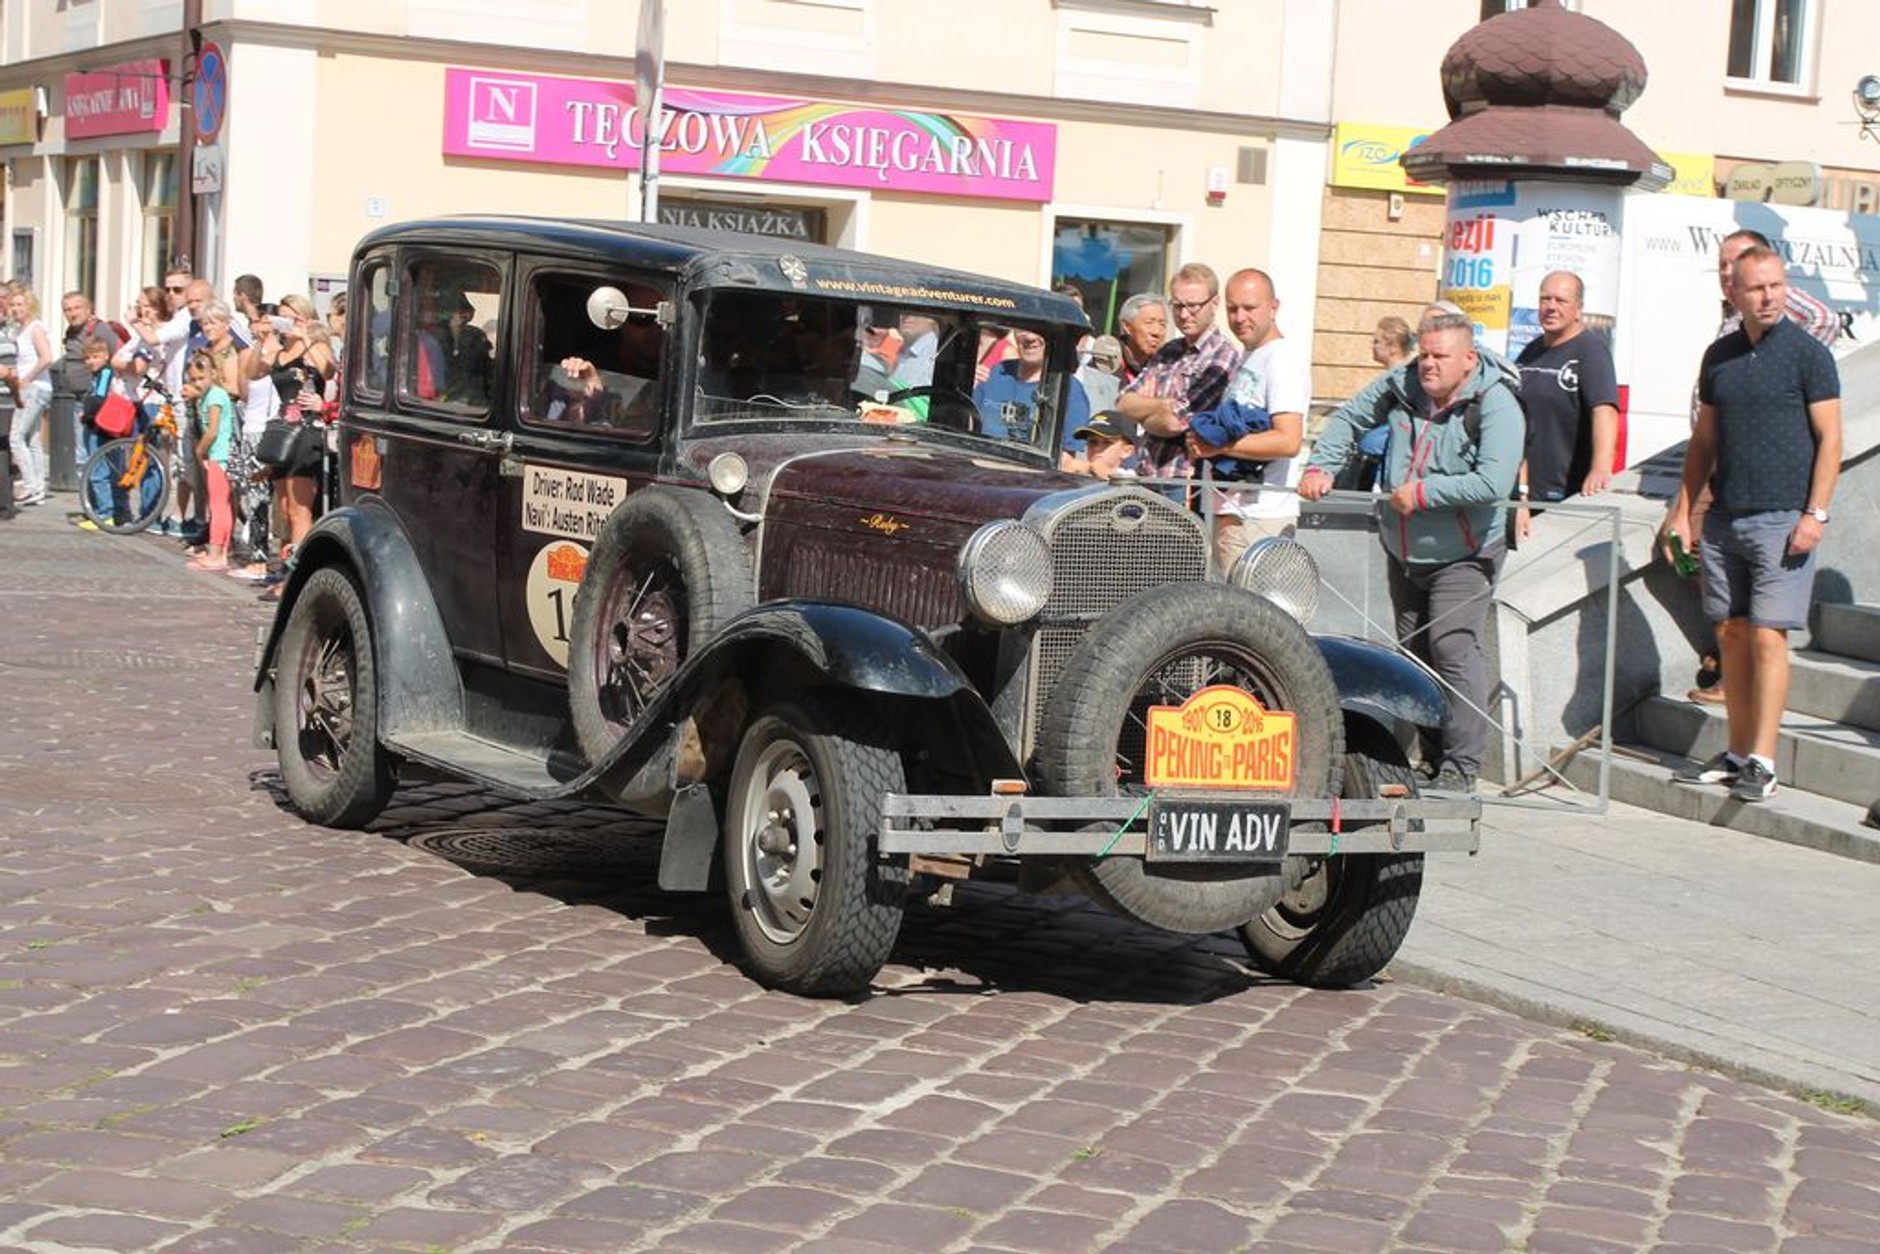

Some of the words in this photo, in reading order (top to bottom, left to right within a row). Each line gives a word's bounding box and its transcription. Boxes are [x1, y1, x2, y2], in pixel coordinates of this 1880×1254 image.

[486, 86, 519, 123] N
[565, 100, 771, 160] TĘCZOWA
[800, 121, 1040, 182] KSIĘGARNIA
[1446, 257, 1493, 288] 2016
[566, 476, 585, 502] Rod
[587, 478, 615, 507] Wade
[547, 588, 577, 642] 1
[1215, 709, 1232, 728] 18
[1170, 812, 1217, 851] VIN
[1224, 812, 1281, 851] ADV
